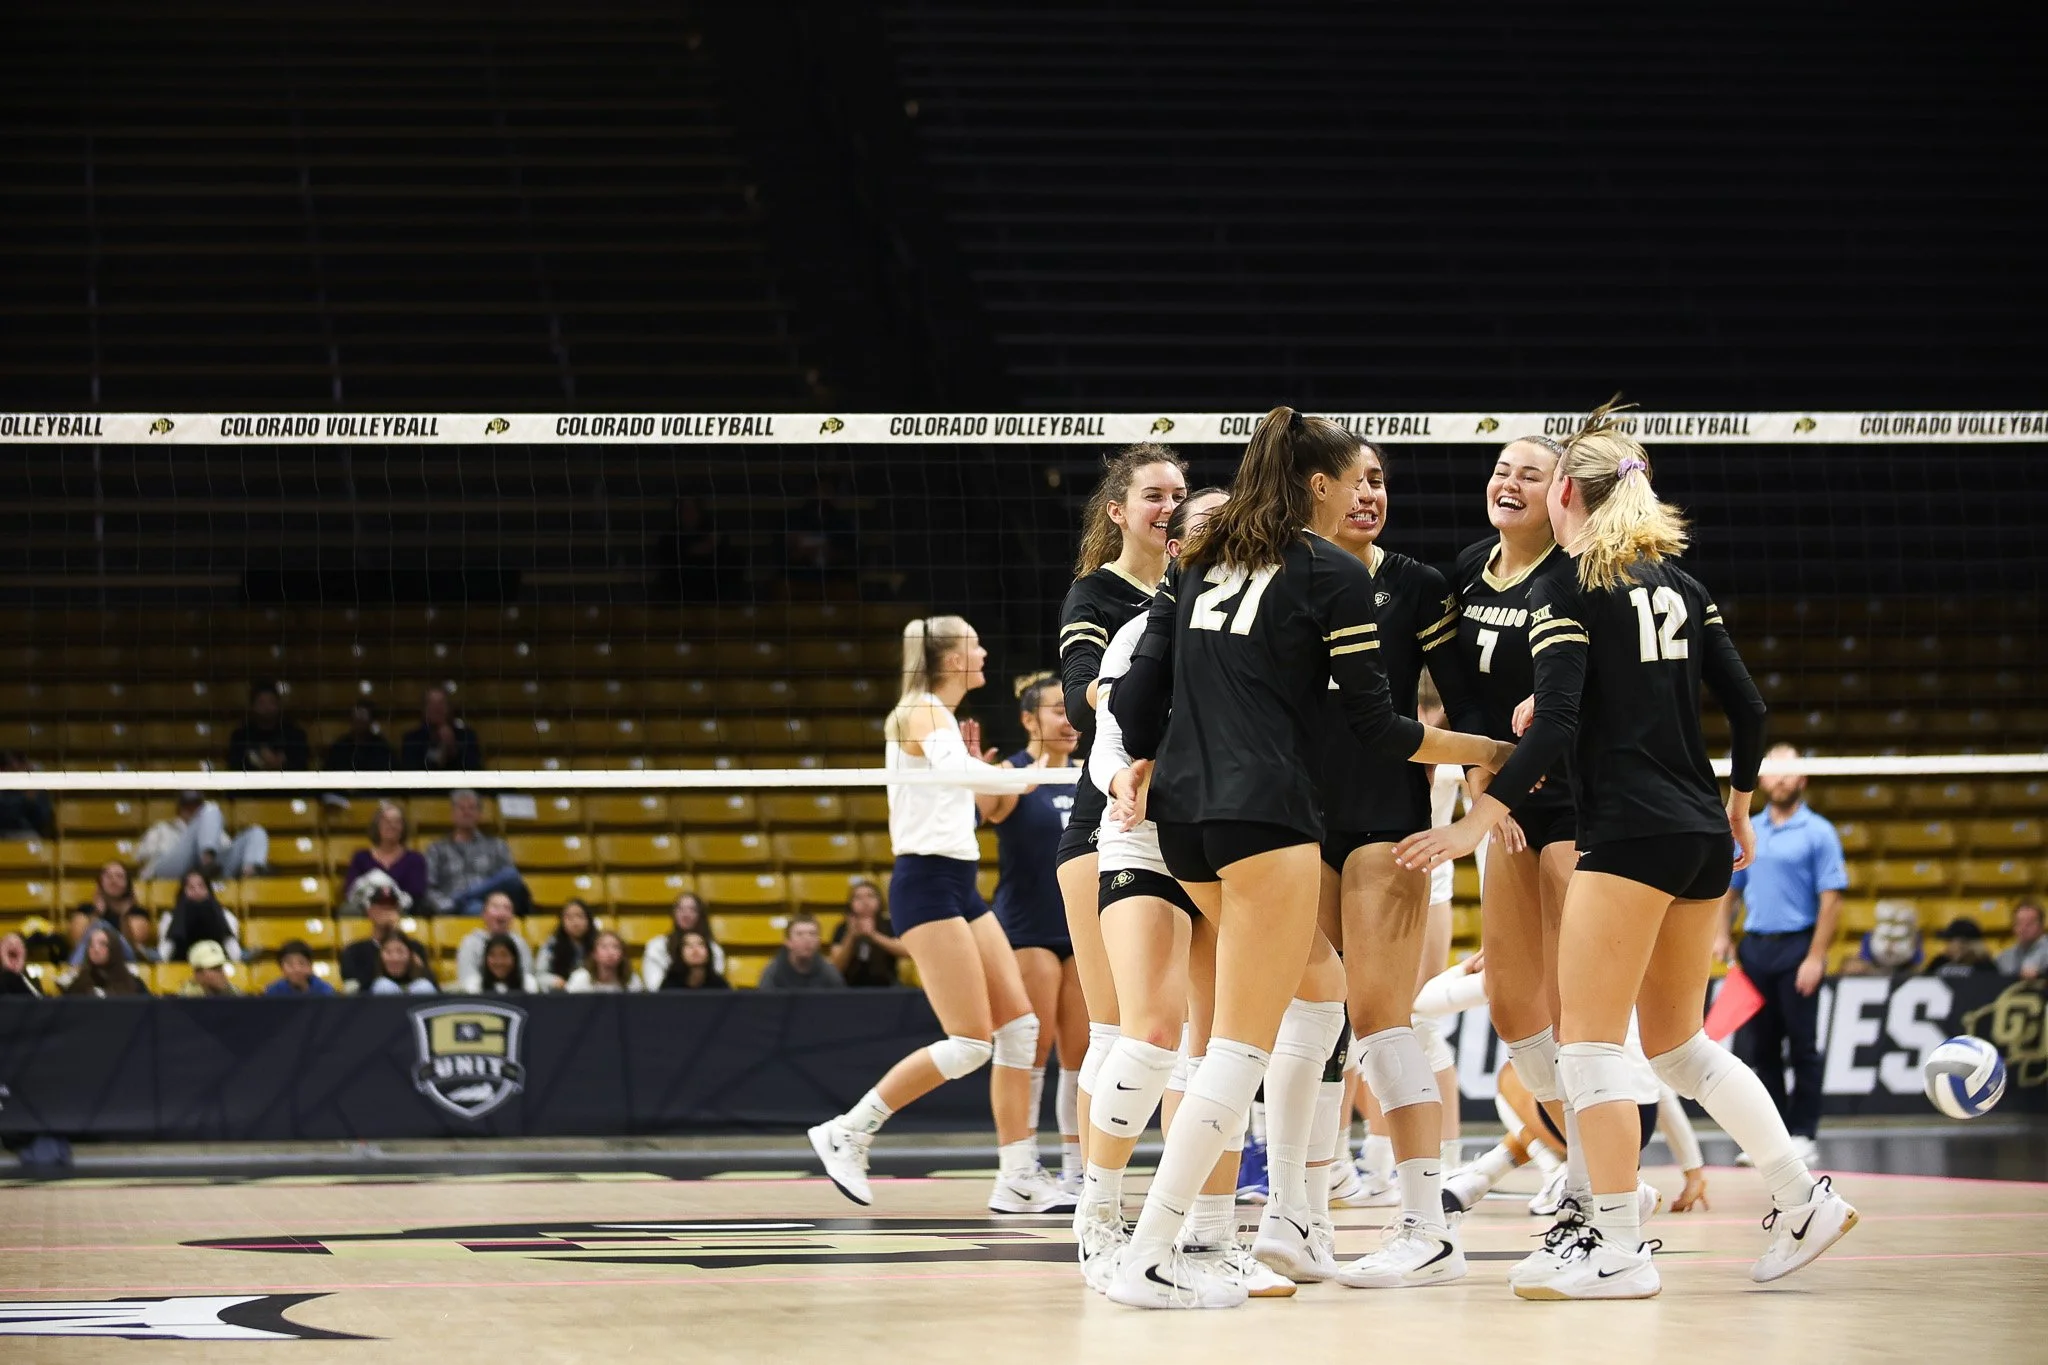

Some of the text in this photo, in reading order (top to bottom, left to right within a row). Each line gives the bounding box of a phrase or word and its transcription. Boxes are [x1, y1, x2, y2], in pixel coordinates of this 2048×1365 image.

[0, 416, 103, 436] OLLEYBALL
[219, 416, 439, 437] COLORADO VOLLEYBALL
[555, 416, 774, 436] COLORADO VOLLEYBALL
[889, 416, 1105, 436] COLORADO VOLLEYBALL
[1328, 416, 1431, 435] OLLEYBALL
[1643, 416, 1750, 436] VOLLEYBALL
[1859, 416, 1951, 435] COLORADO
[1189, 561, 1282, 636] 21
[1628, 585, 1689, 663] 12
[1476, 628, 1500, 674] 7
[433, 1055, 503, 1079] UNIT
